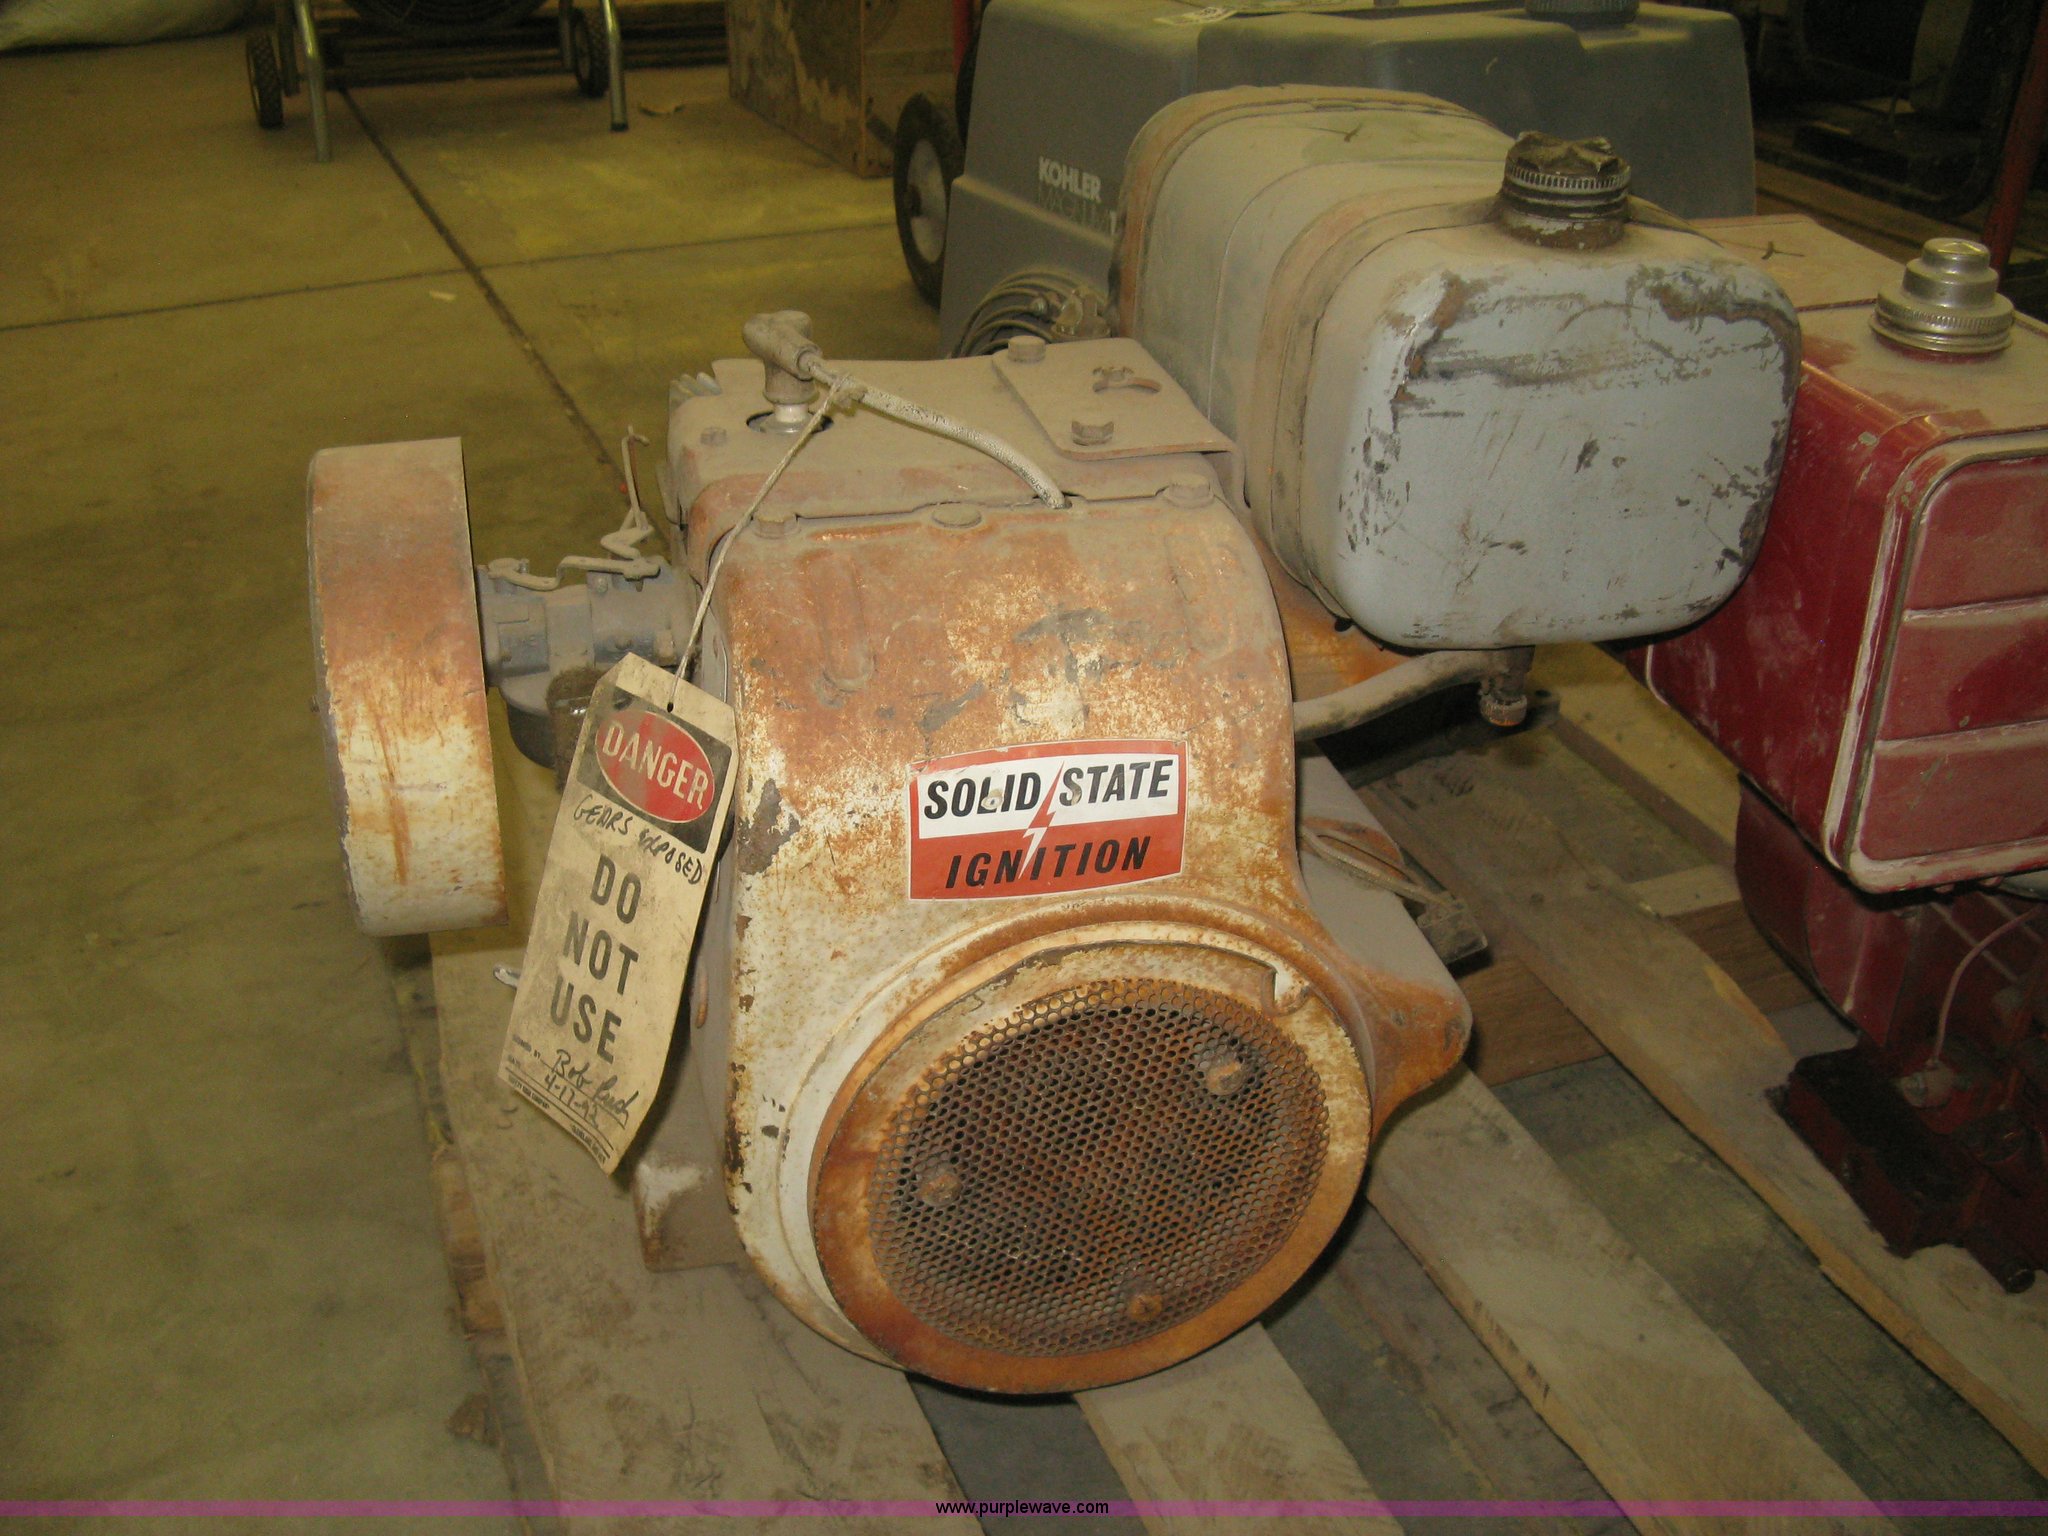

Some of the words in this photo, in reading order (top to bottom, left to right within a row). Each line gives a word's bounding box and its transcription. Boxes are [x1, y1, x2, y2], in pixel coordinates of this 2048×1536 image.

[1038, 156, 1102, 204] KOHLER
[602, 720, 710, 810] DANGER
[923, 771, 1042, 820] SOLID
[1059, 759, 1174, 807] STATE
[573, 793, 633, 836] GEARS
[590, 853, 642, 924] DO
[945, 835, 1151, 889] IGNITION
[563, 910, 639, 996] NOT
[550, 974, 622, 1065] USE
